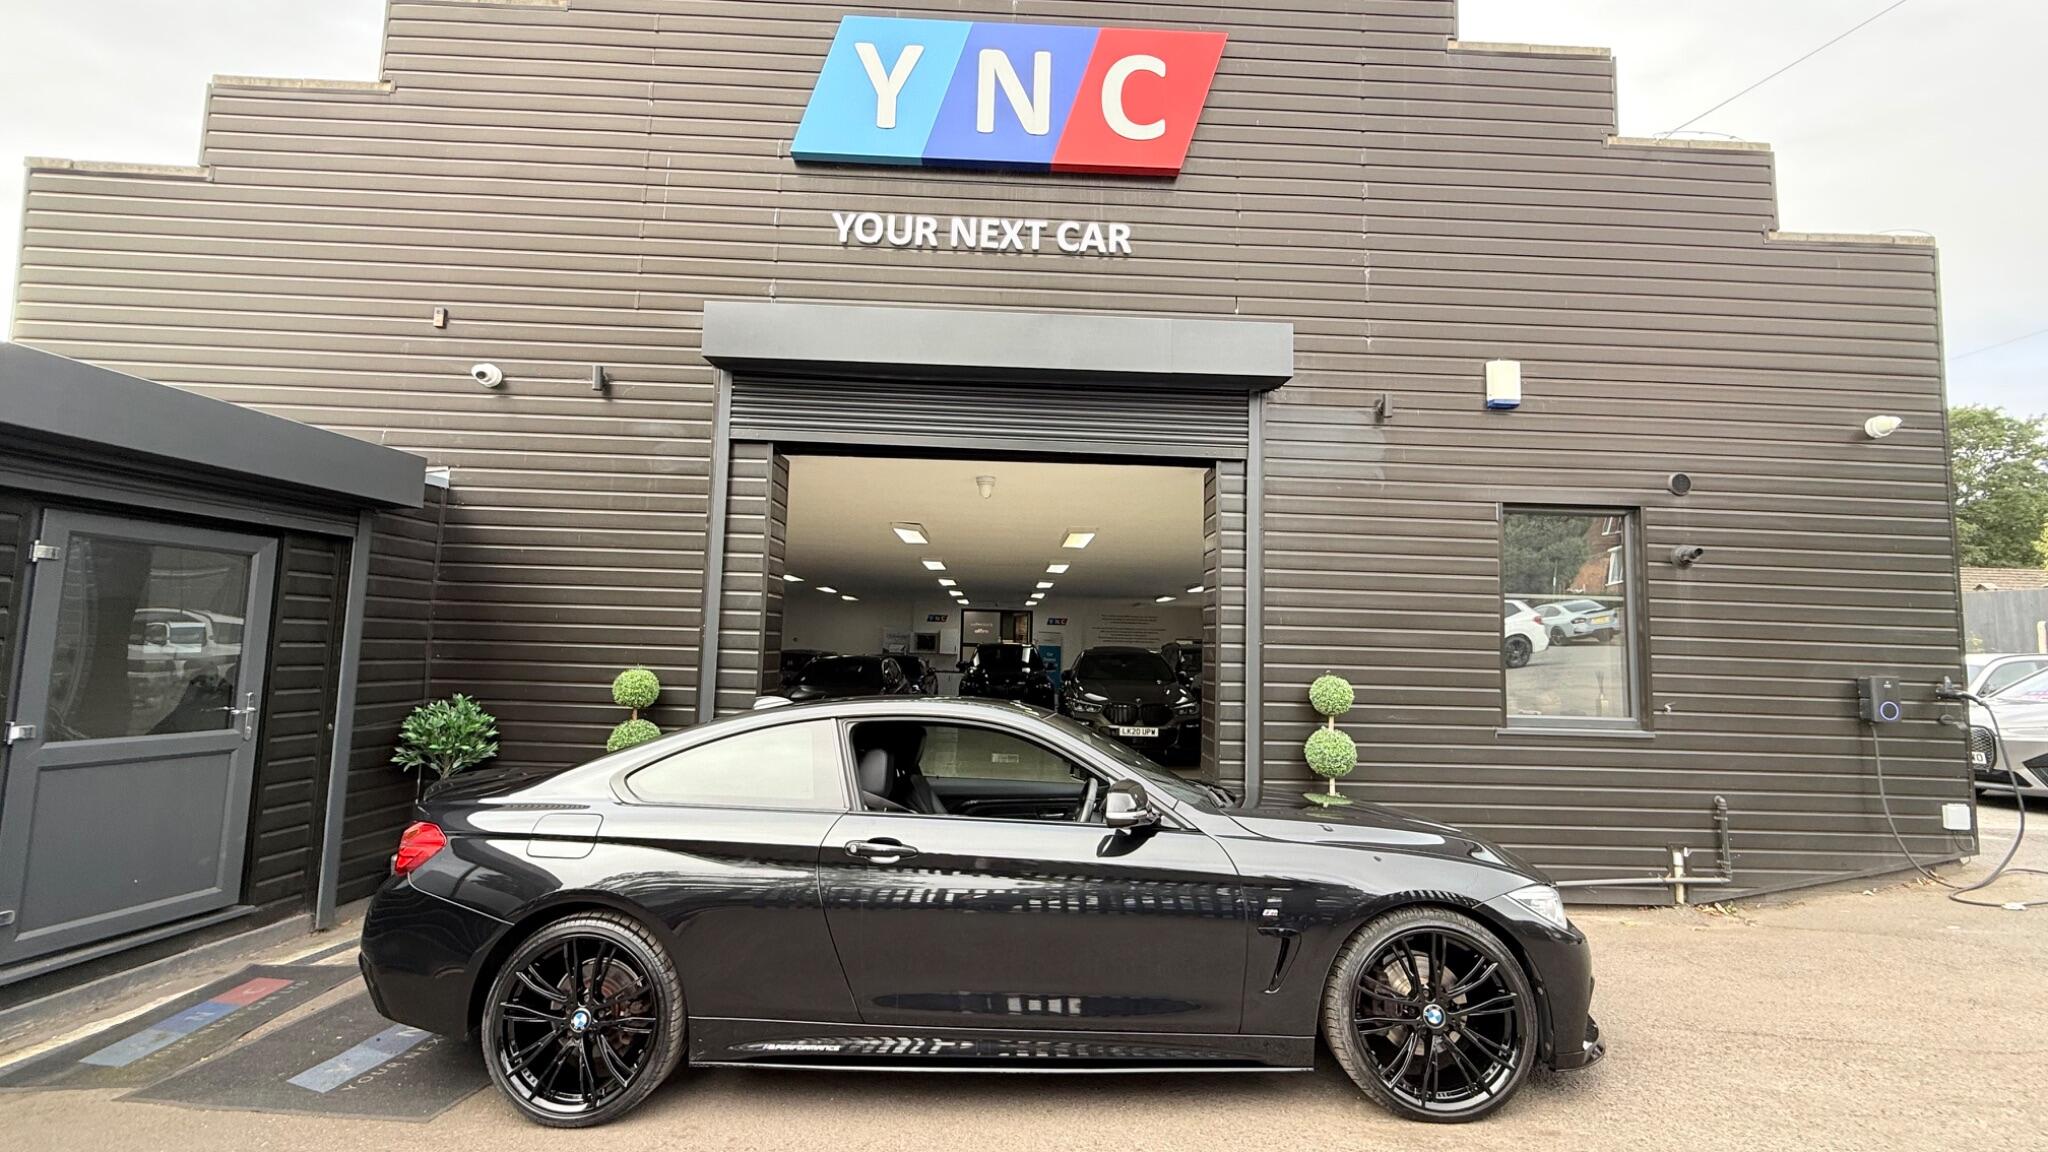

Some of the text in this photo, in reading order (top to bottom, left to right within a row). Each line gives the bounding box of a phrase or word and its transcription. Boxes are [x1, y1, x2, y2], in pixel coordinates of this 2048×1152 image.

[854, 42, 1167, 141] YNC
[832, 212, 1132, 254] YOUR NEXT CAR
[404, 1034, 444, 1059] NEX
